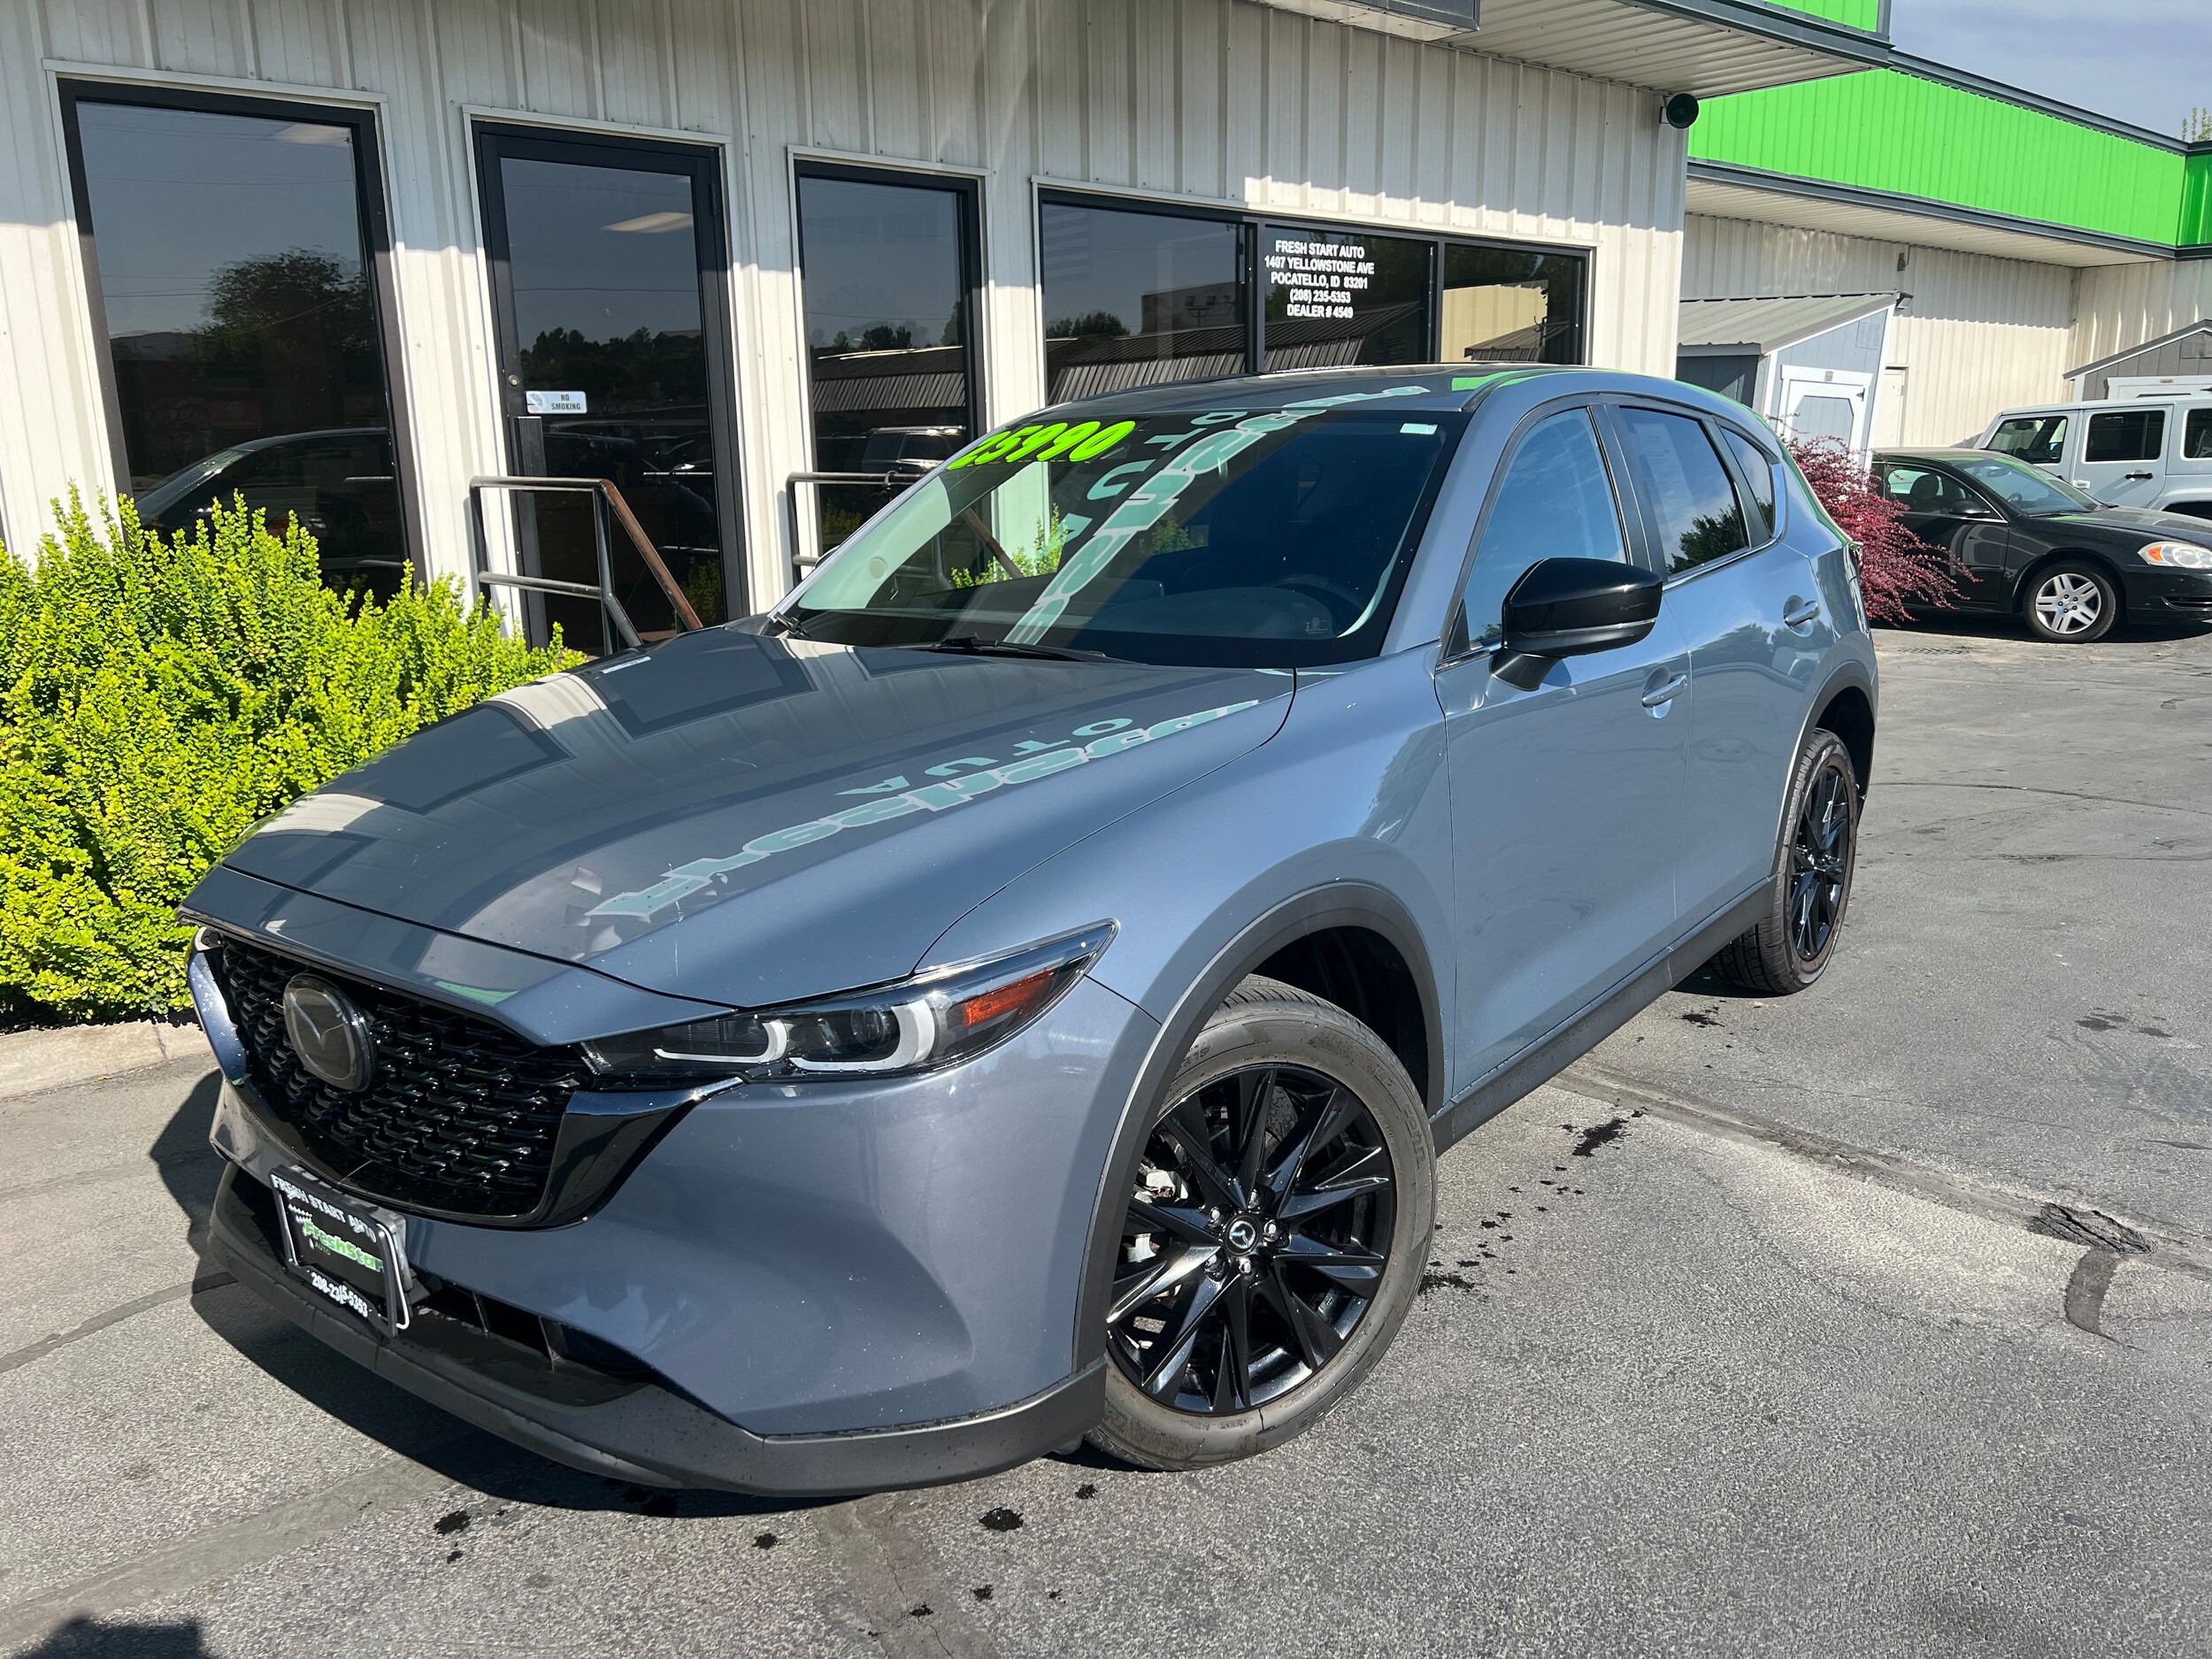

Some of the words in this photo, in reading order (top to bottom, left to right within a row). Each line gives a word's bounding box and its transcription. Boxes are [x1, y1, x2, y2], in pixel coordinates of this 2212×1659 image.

[1275, 240, 1307, 255] FRESH
[1309, 242, 1339, 257] START
[1339, 245, 1364, 259] AUTO
[1264, 256, 1286, 268] 1407
[1286, 257, 1356, 273] YELLOWSTONE
[1356, 262, 1374, 274] AVE
[1271, 272, 1329, 288] POCATELLO,
[1331, 275, 1340, 288] ID
[1343, 276, 1368, 288] 83201
[1290, 288, 1312, 303] (208)
[1313, 290, 1351, 303] 235-5353
[1287, 303, 1325, 318] DEALER
[1325, 305, 1332, 318] #
[1333, 305, 1353, 319] 4549
[947, 420, 1136, 470] 25990
[271, 1173, 310, 1204] FRESH
[308, 1194, 346, 1223] START
